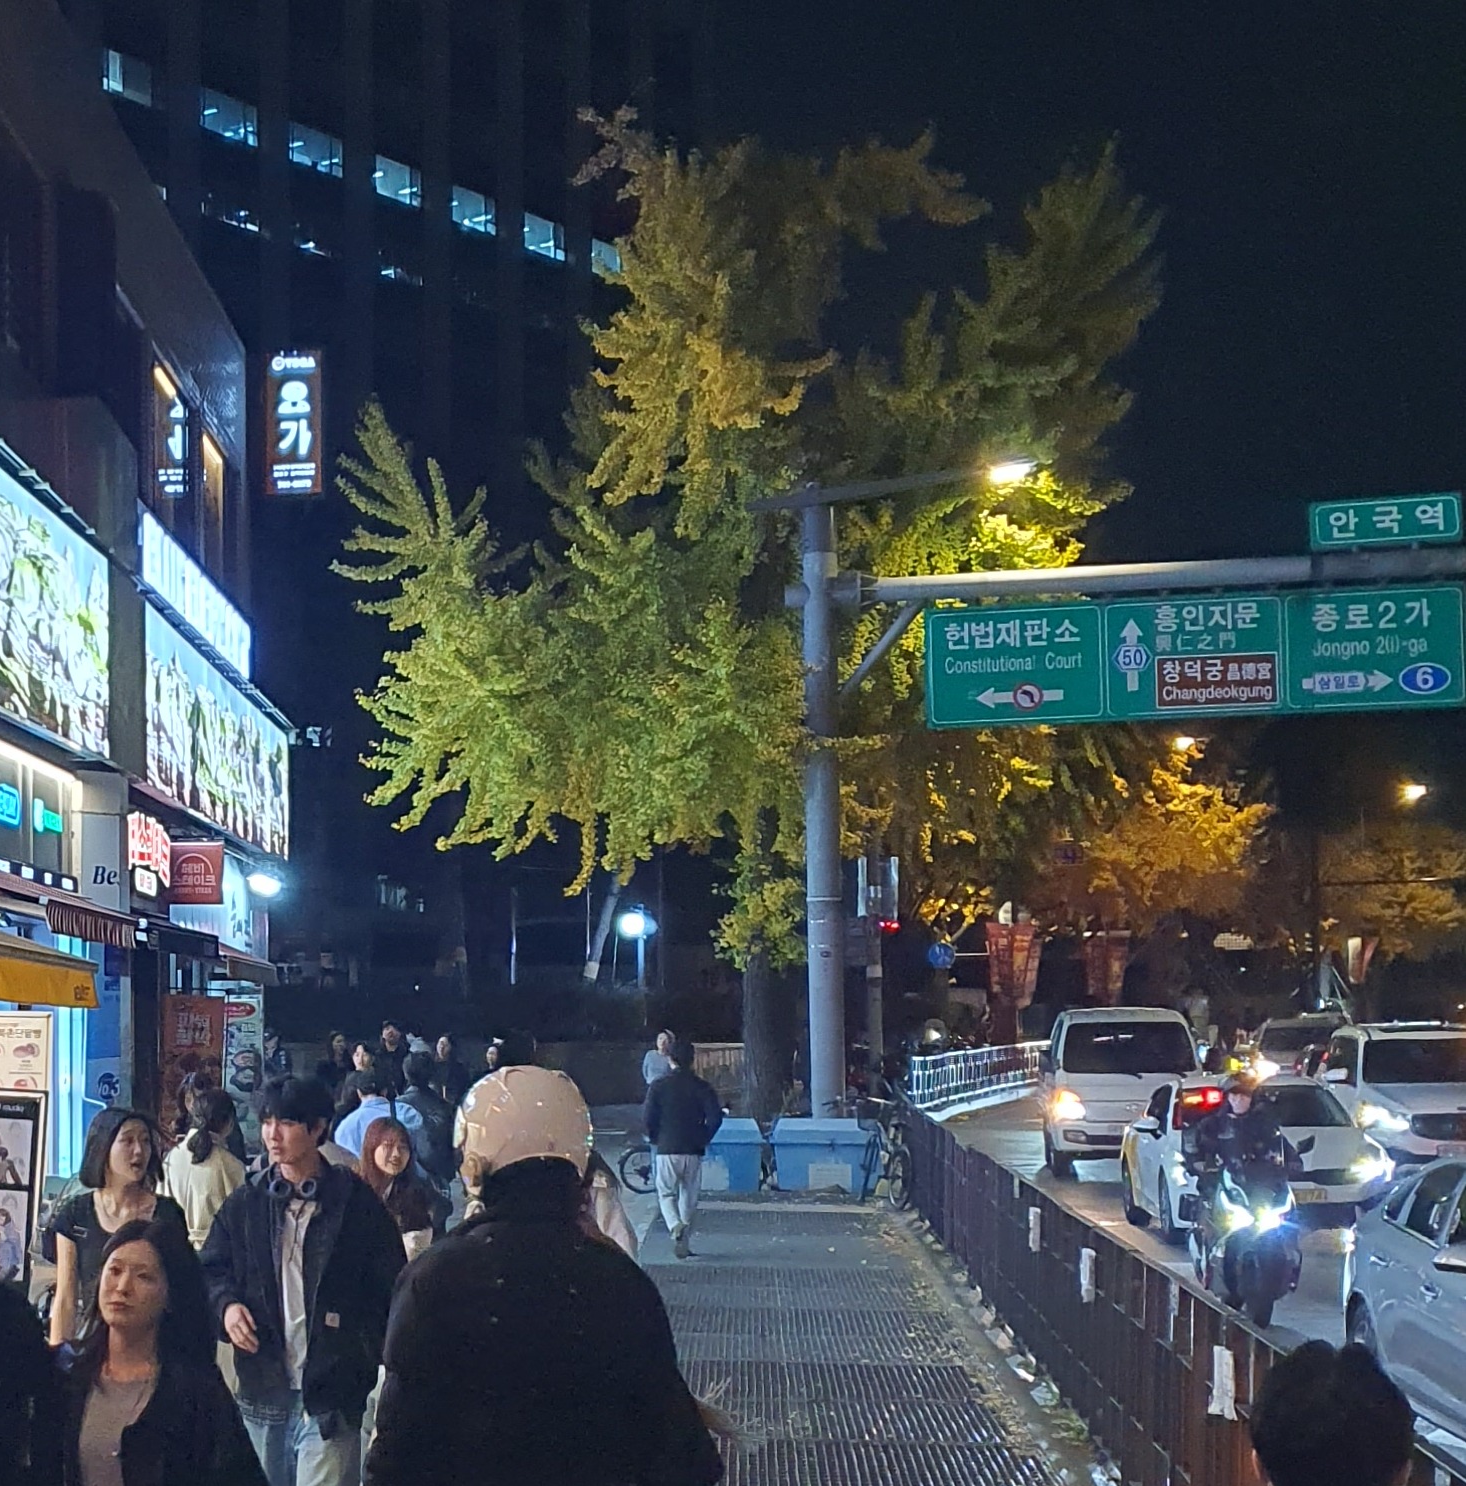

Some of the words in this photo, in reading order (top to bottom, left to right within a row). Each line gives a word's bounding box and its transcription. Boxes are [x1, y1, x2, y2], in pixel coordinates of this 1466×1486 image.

[277, 380, 312, 456] 요가
[1329, 502, 1444, 538] 안국역
[1154, 602, 1260, 632] 흥인지문
[1311, 598, 1431, 632] 종로2가
[944, 618, 1081, 650] 헌법재판소
[1156, 631, 1236, 652] 興仁之門
[1122, 649, 1143, 666] 50
[1313, 638, 1370, 660] Jongno
[944, 654, 1035, 674] Constitutional
[1045, 651, 1082, 670] Court
[1162, 659, 1224, 682] 창덕궁
[1318, 674, 1360, 691] 삼일로
[1416, 667, 1434, 689] 6
[1162, 685, 1273, 702] Changdeokgung
